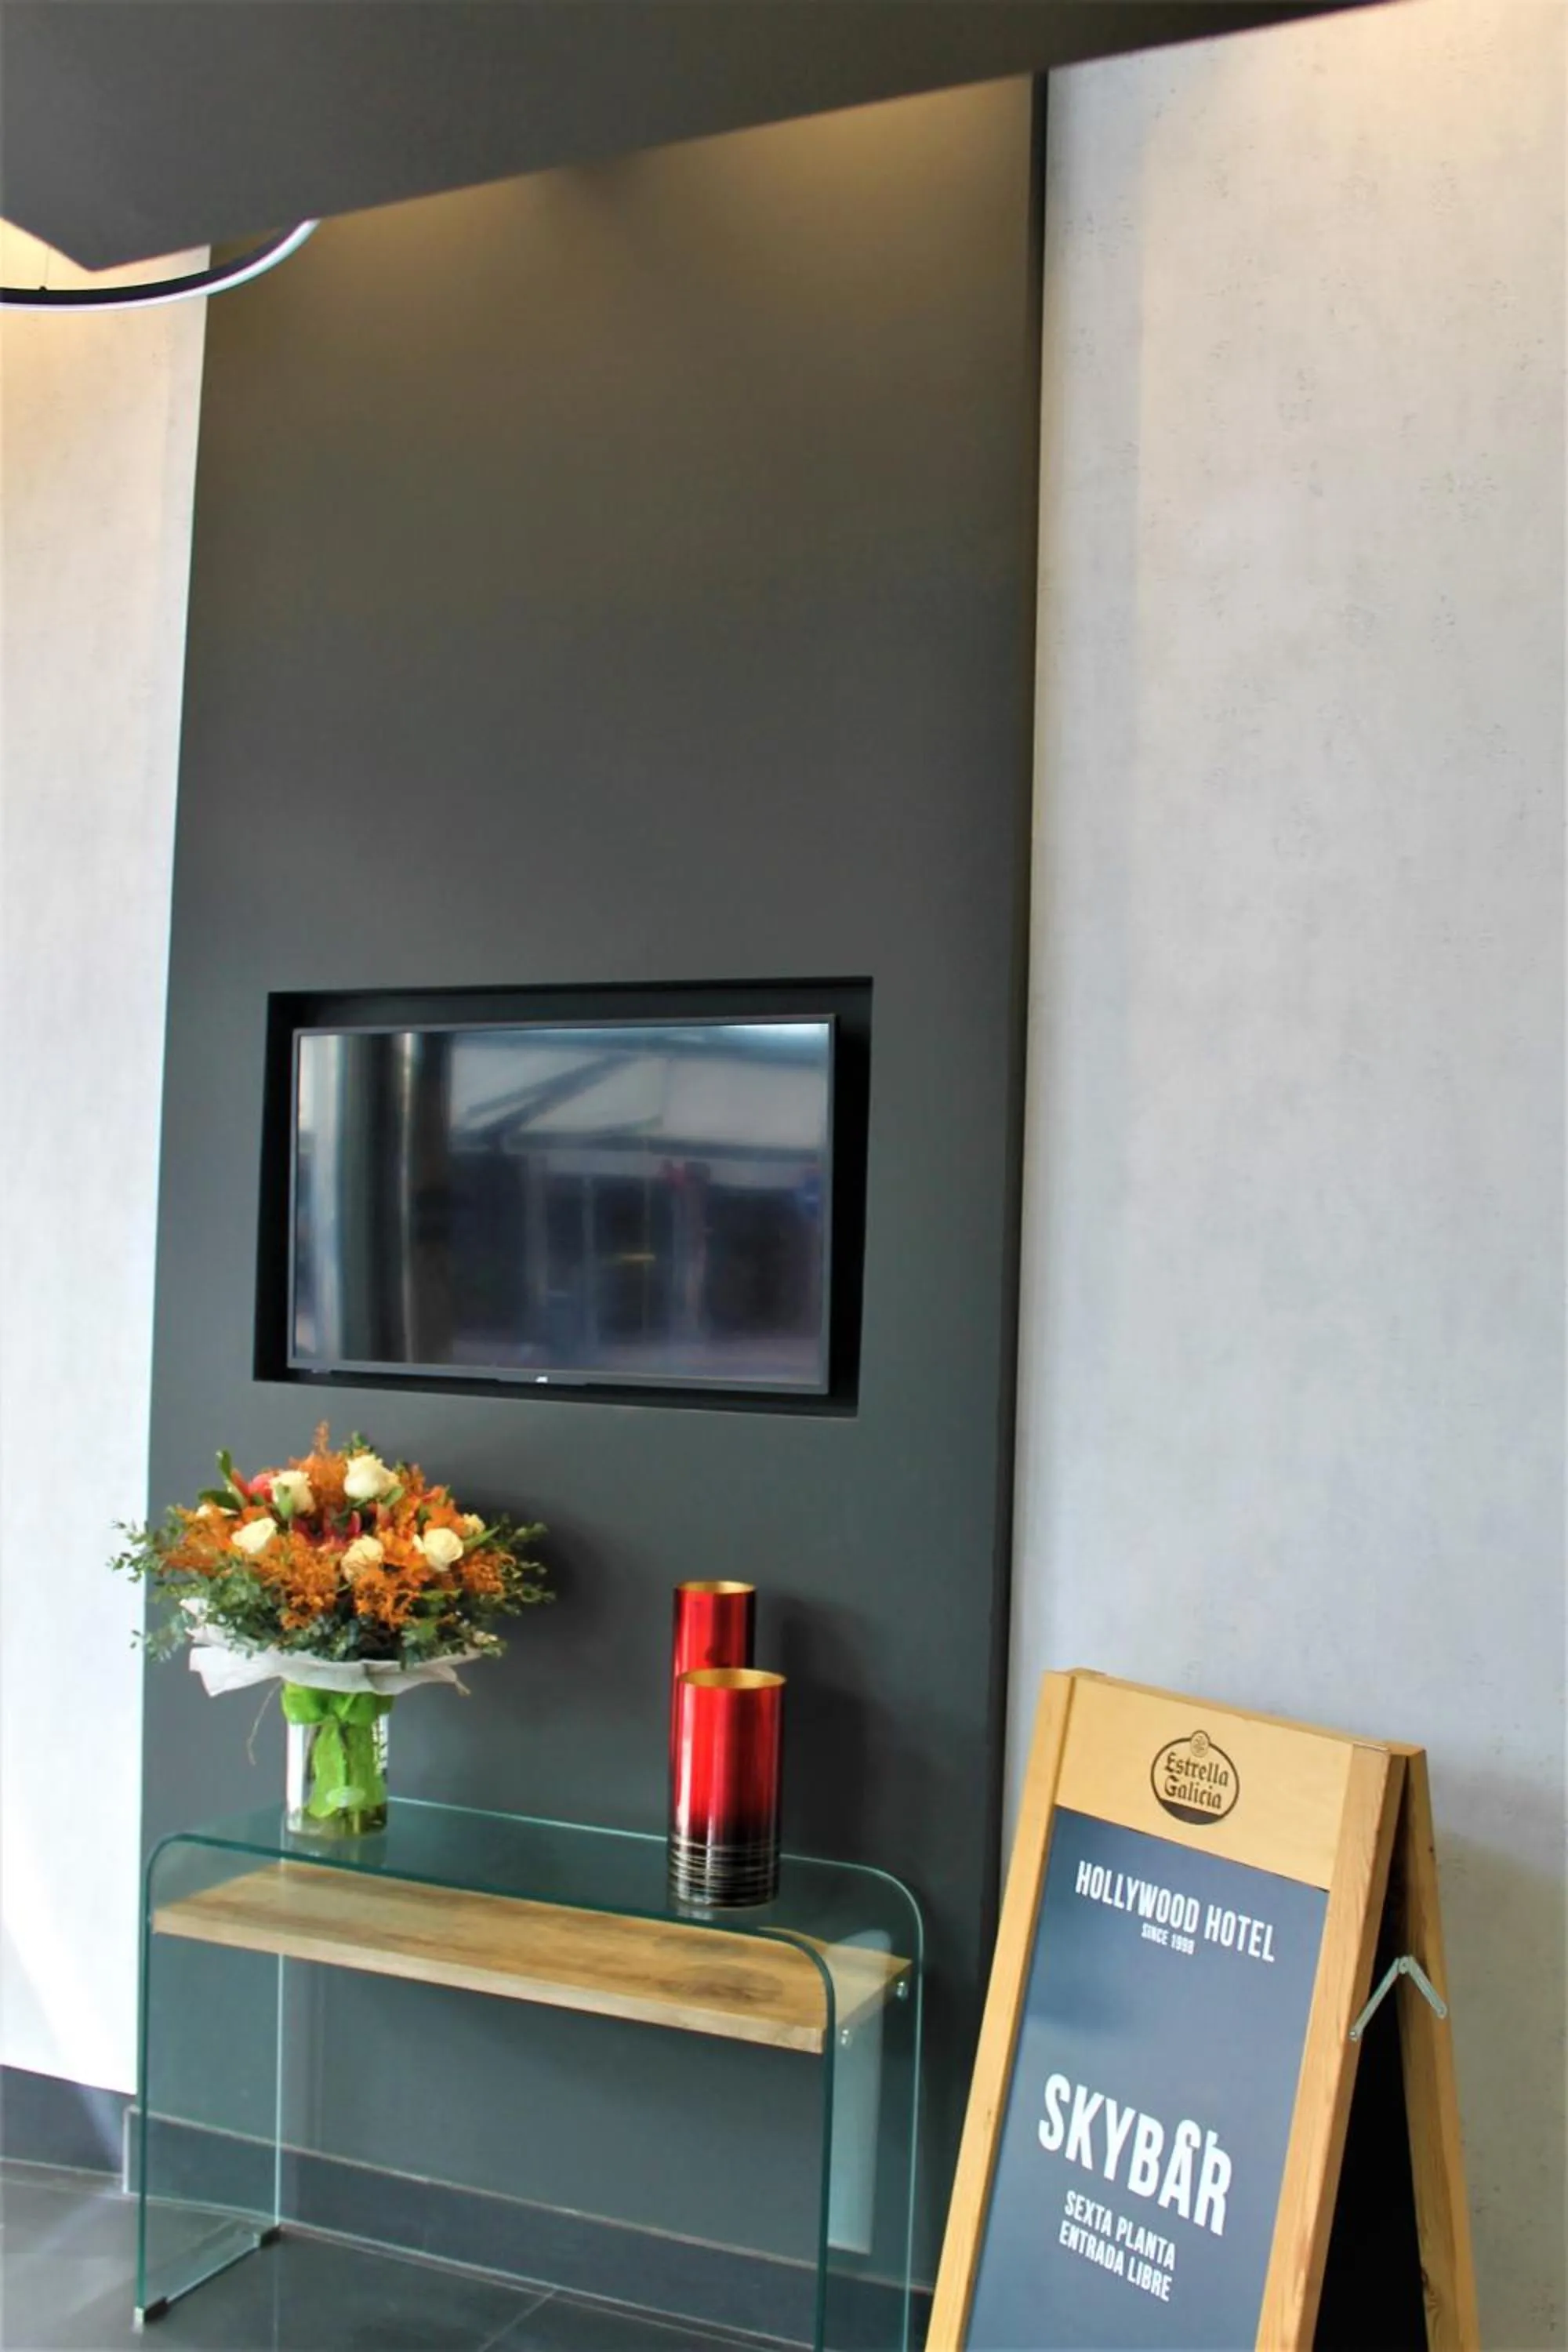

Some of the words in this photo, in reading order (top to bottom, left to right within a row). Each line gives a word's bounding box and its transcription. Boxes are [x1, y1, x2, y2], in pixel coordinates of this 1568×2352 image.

[1164, 1751, 1229, 1788] Estrella
[1164, 1774, 1222, 1809] Galicia
[1075, 1860, 1200, 1934] HOLLYWOOD
[1203, 1904, 1275, 1962] HOTEL
[1142, 1922, 1169, 1946] SINCE
[1038, 2072, 1232, 2237] SKYBAR
[1059, 2220, 1124, 2277] ENTRADA
[1127, 2256, 1173, 2303] LIBRE
[1065, 2189, 1112, 2237] SEXTA
[1116, 2216, 1175, 2271] PLANTA
